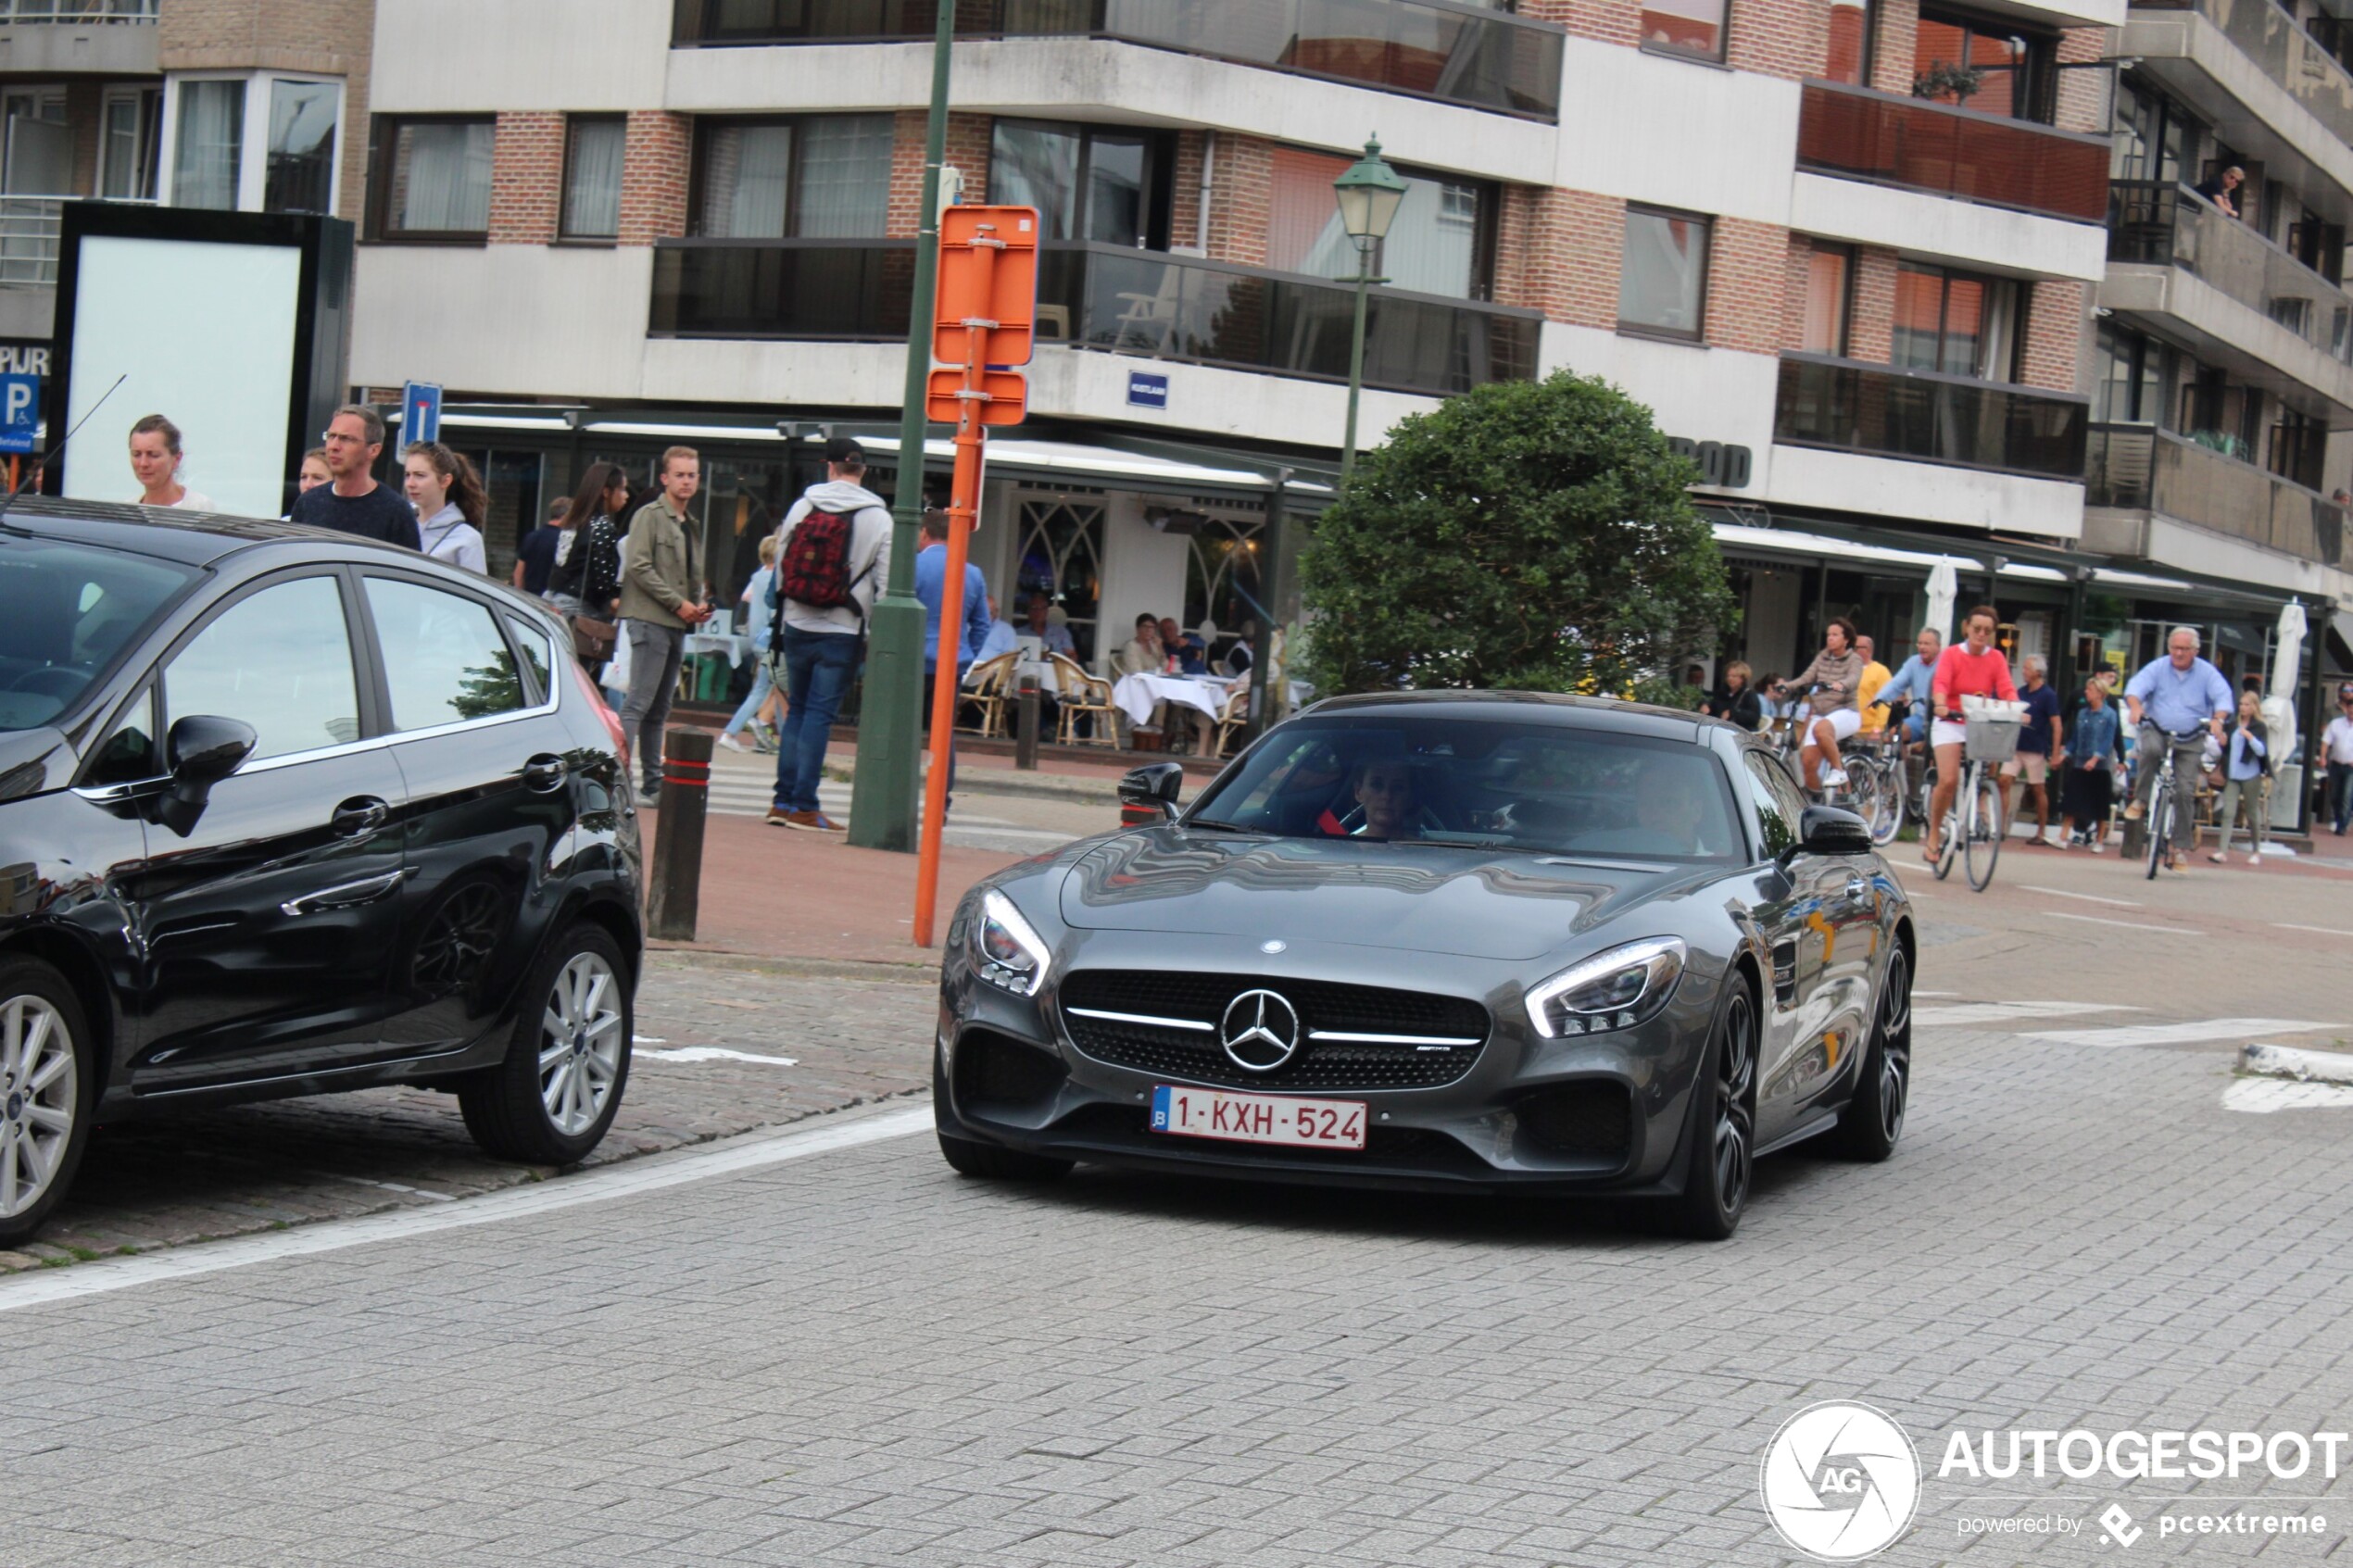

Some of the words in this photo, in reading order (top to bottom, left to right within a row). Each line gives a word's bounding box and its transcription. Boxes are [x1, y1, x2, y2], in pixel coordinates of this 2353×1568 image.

[6, 383, 31, 425] P
[1155, 1110, 1166, 1126] B
[1177, 1097, 1360, 1141] 1-KXH-524
